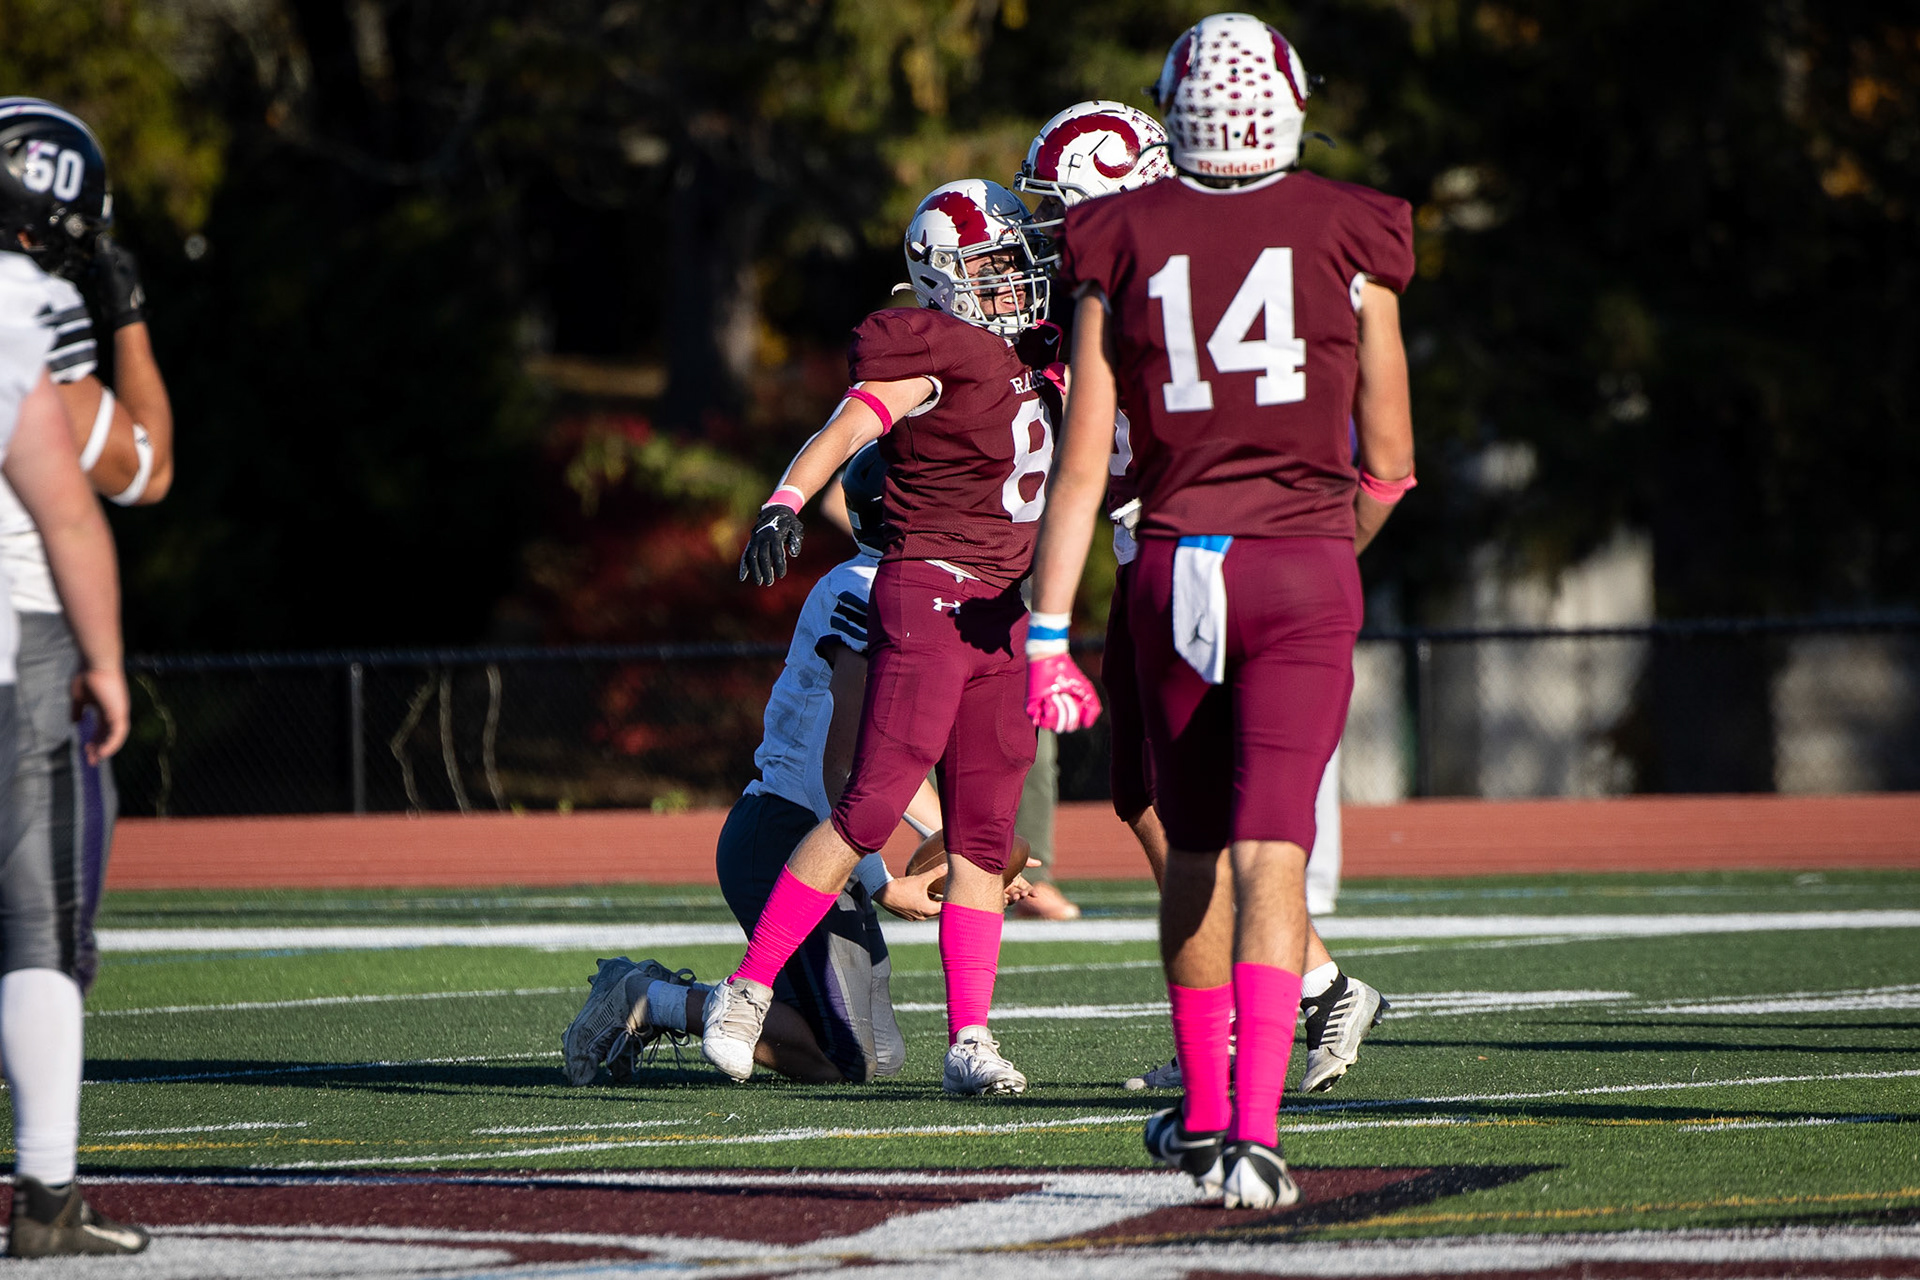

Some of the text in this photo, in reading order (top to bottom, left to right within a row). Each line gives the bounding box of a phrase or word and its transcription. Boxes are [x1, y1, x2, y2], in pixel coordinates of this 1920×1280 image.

[1219, 121, 1259, 150] 14
[22, 139, 85, 202] 50
[1197, 157, 1275, 174] Riddell
[1148, 247, 1307, 413] 14
